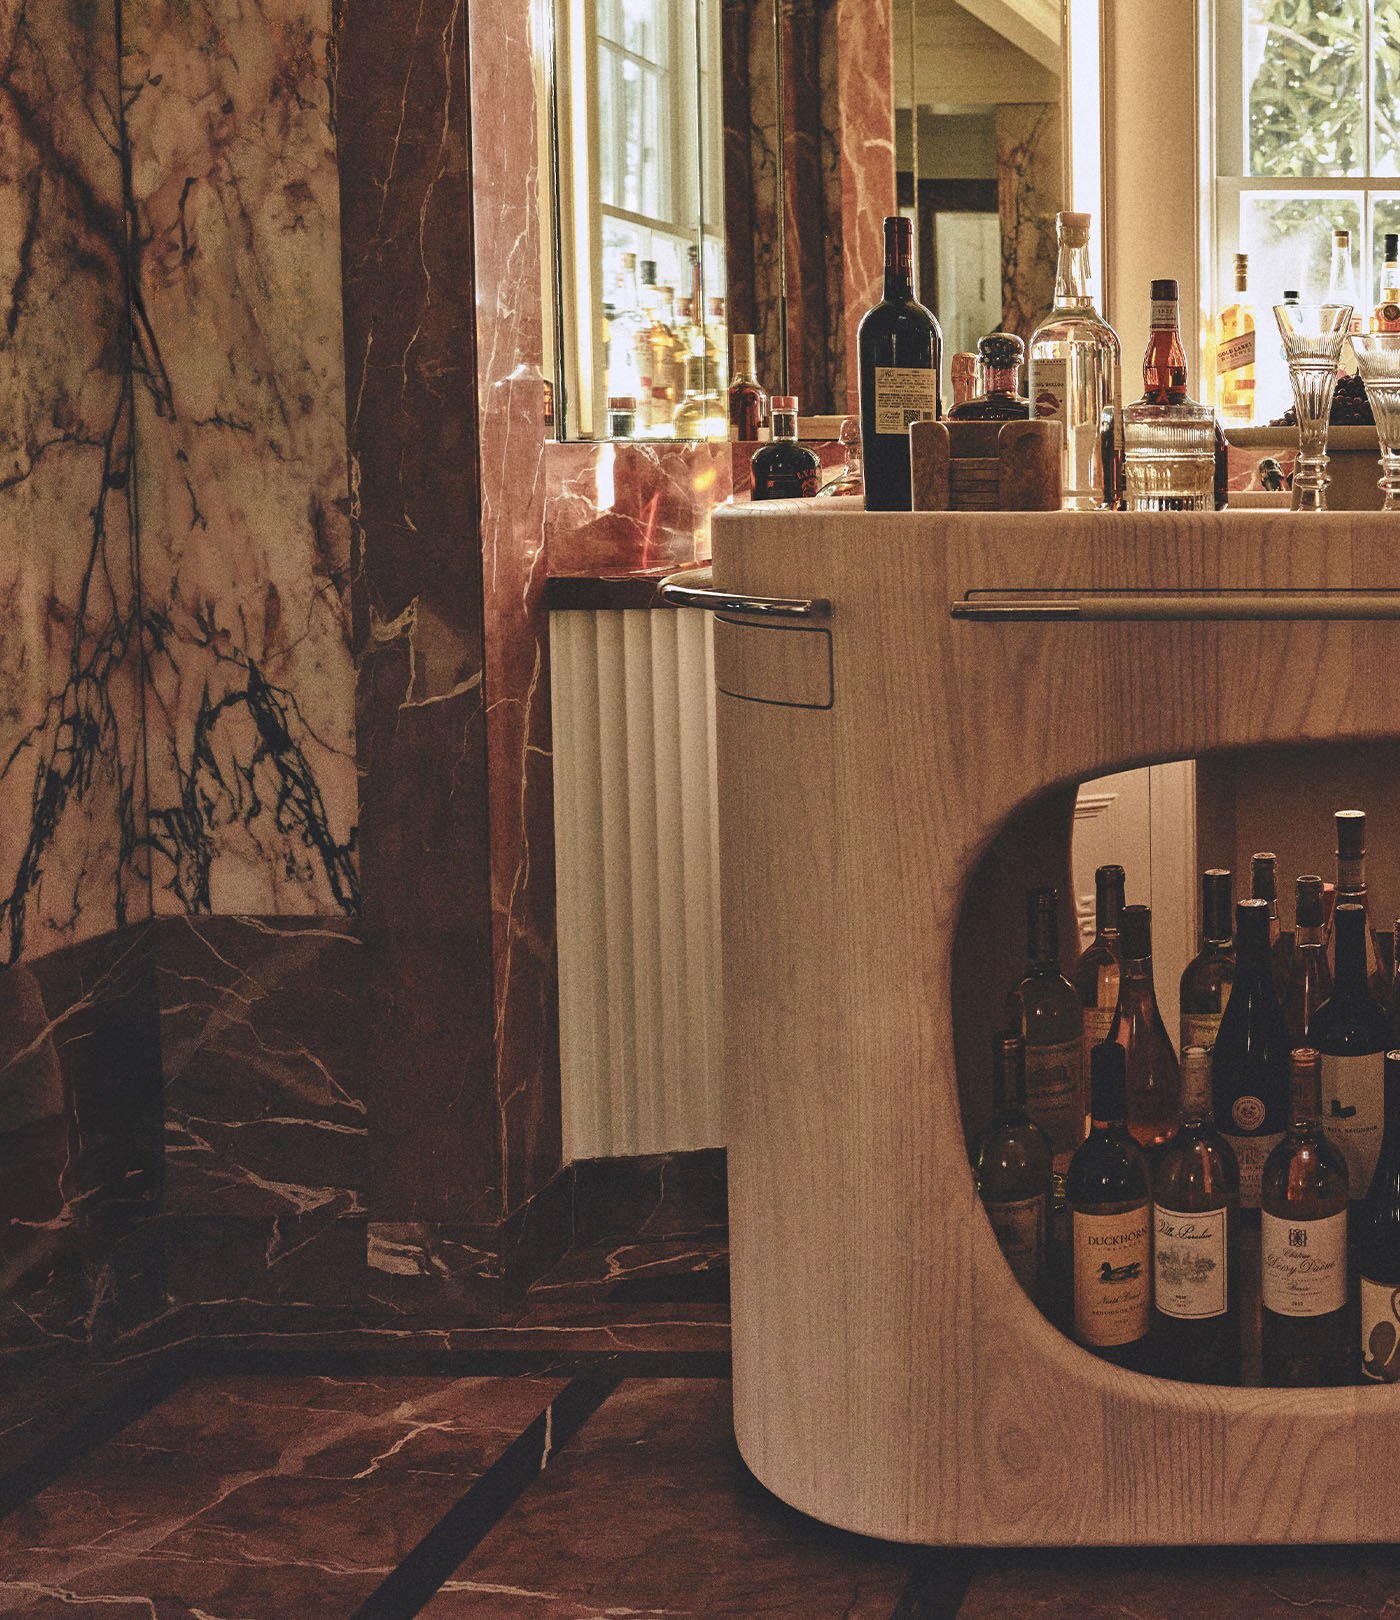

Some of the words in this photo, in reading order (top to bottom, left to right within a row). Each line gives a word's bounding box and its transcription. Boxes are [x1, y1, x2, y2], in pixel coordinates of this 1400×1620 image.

[1217, 349, 1233, 358] GOLD
[1234, 342, 1252, 352] LABEL
[1222, 348, 1251, 362] RESERVE
[1088, 1227, 1147, 1246] DUCKHORN
